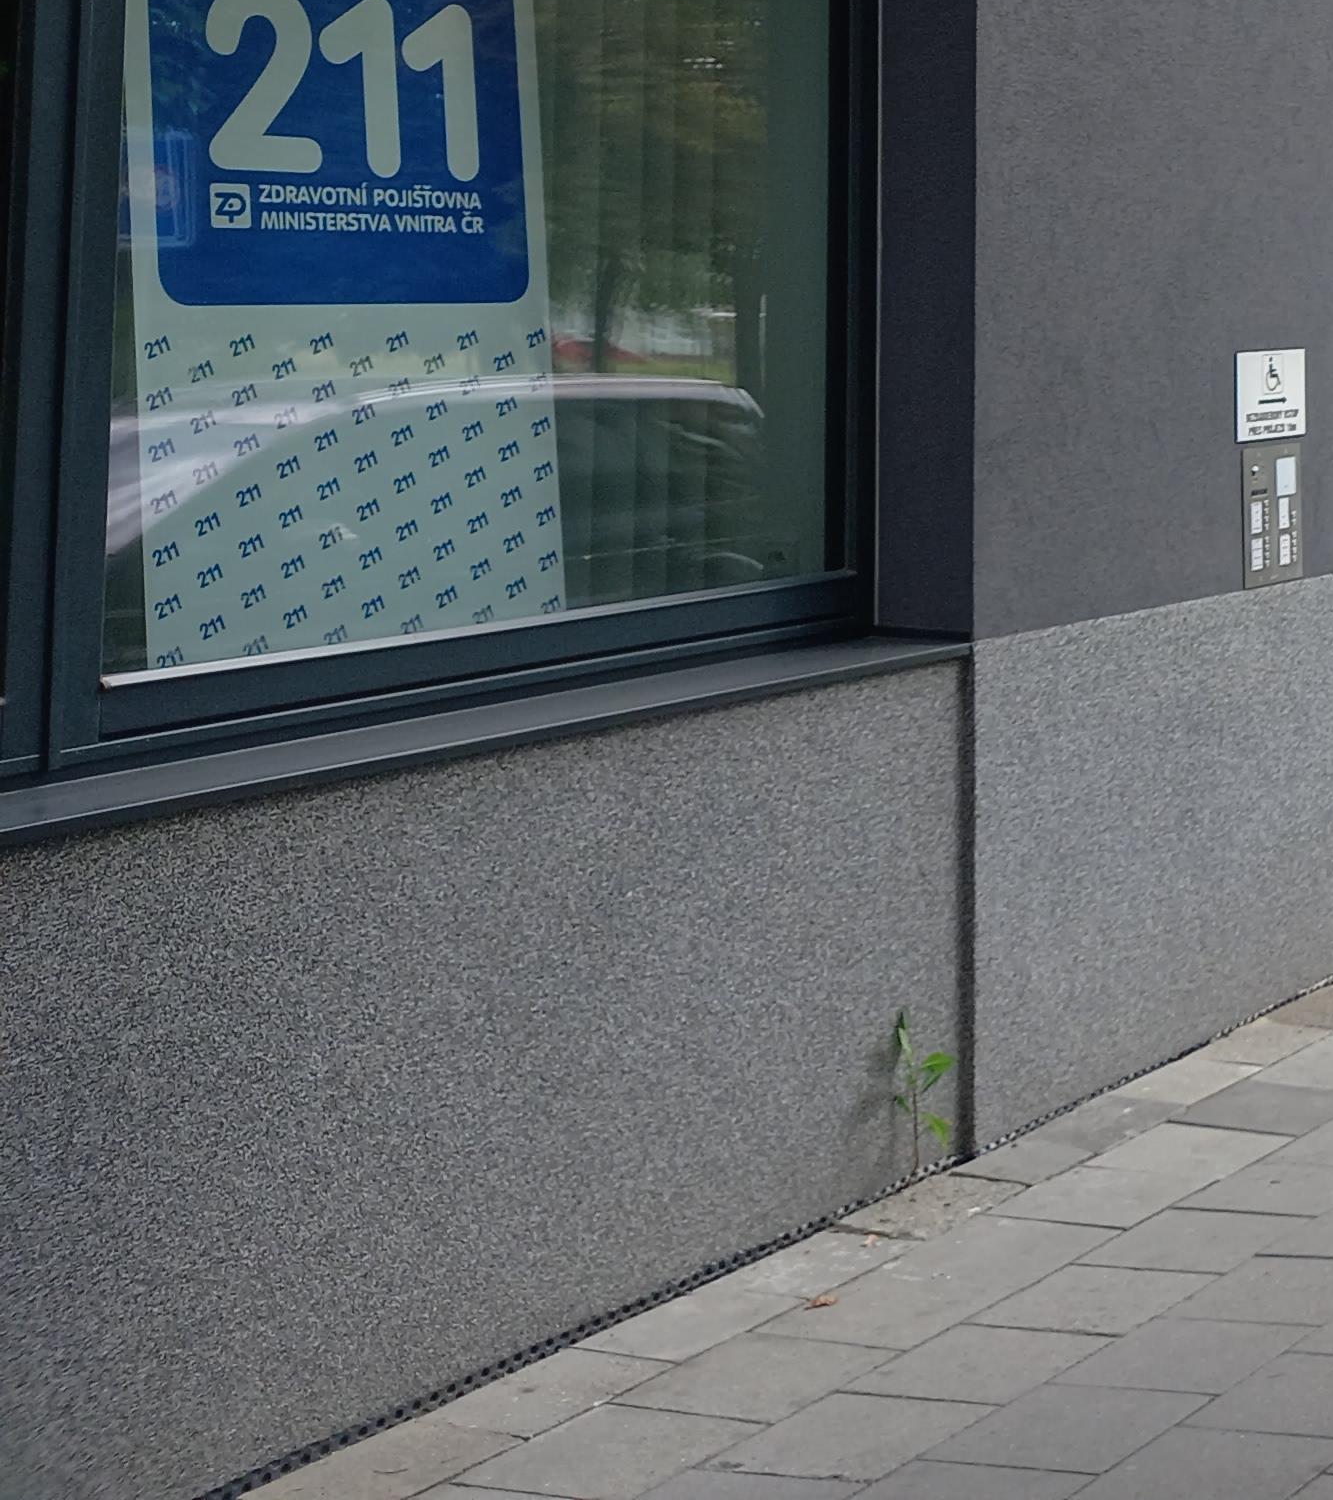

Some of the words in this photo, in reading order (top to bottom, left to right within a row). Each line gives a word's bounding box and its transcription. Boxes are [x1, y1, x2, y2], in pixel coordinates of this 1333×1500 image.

[259, 183, 368, 206] ZDRAVOTNÍ
[373, 184, 482, 210] POJIŠŤOVNA
[260, 210, 391, 232] MINISTERSTVA
[395, 213, 456, 234] VNITRA
[461, 211, 484, 234] ČR
[144, 336, 171, 359] 211
[230, 334, 255, 357] 211
[310, 332, 333, 354] 211
[386, 331, 409, 352] 211
[457, 330, 479, 351] 211
[526, 328, 546, 348] 211
[272, 358, 296, 379] 211
[493, 351, 515, 372] 211
[146, 387, 172, 411] 211
[232, 384, 257, 407] 211
[312, 380, 336, 402] 211
[352, 404, 375, 425] 211
[426, 400, 448, 420] 211
[496, 397, 517, 417] 211
[148, 438, 175, 462] 211
[314, 429, 338, 452] 211
[391, 425, 414, 447] 211
[462, 421, 483, 442] 211
[531, 417, 550, 437] 211
[277, 455, 300, 479] 211
[354, 450, 378, 473] 211
[428, 446, 450, 467] 211
[498, 441, 520, 462] 211
[236, 484, 261, 508] 211
[317, 477, 340, 501] 211
[393, 472, 416, 494] 211
[465, 466, 486, 488] 211
[534, 461, 553, 482] 211
[195, 512, 220, 537] 211
[279, 505, 303, 529] 211
[357, 498, 380, 521] 211
[431, 492, 452, 514] 211
[501, 486, 522, 508] 211
[152, 541, 180, 567] 211
[238, 534, 264, 558] 211
[319, 527, 342, 550] 211
[396, 520, 418, 542] 211
[467, 512, 489, 534] 211
[536, 506, 555, 526] 211
[197, 564, 223, 588] 211
[281, 555, 305, 579] 211
[359, 547, 382, 570] 211
[433, 539, 455, 561] 211
[503, 531, 525, 553] 211
[154, 594, 182, 620] 211
[241, 584, 266, 609] 211
[322, 575, 346, 599] 211
[399, 566, 421, 589] 211
[470, 558, 491, 580] 211
[539, 550, 558, 572] 211
[200, 615, 226, 640] 211
[283, 605, 307, 629] 211
[362, 595, 385, 619] 211
[436, 585, 458, 609] 211
[506, 576, 527, 599] 211
